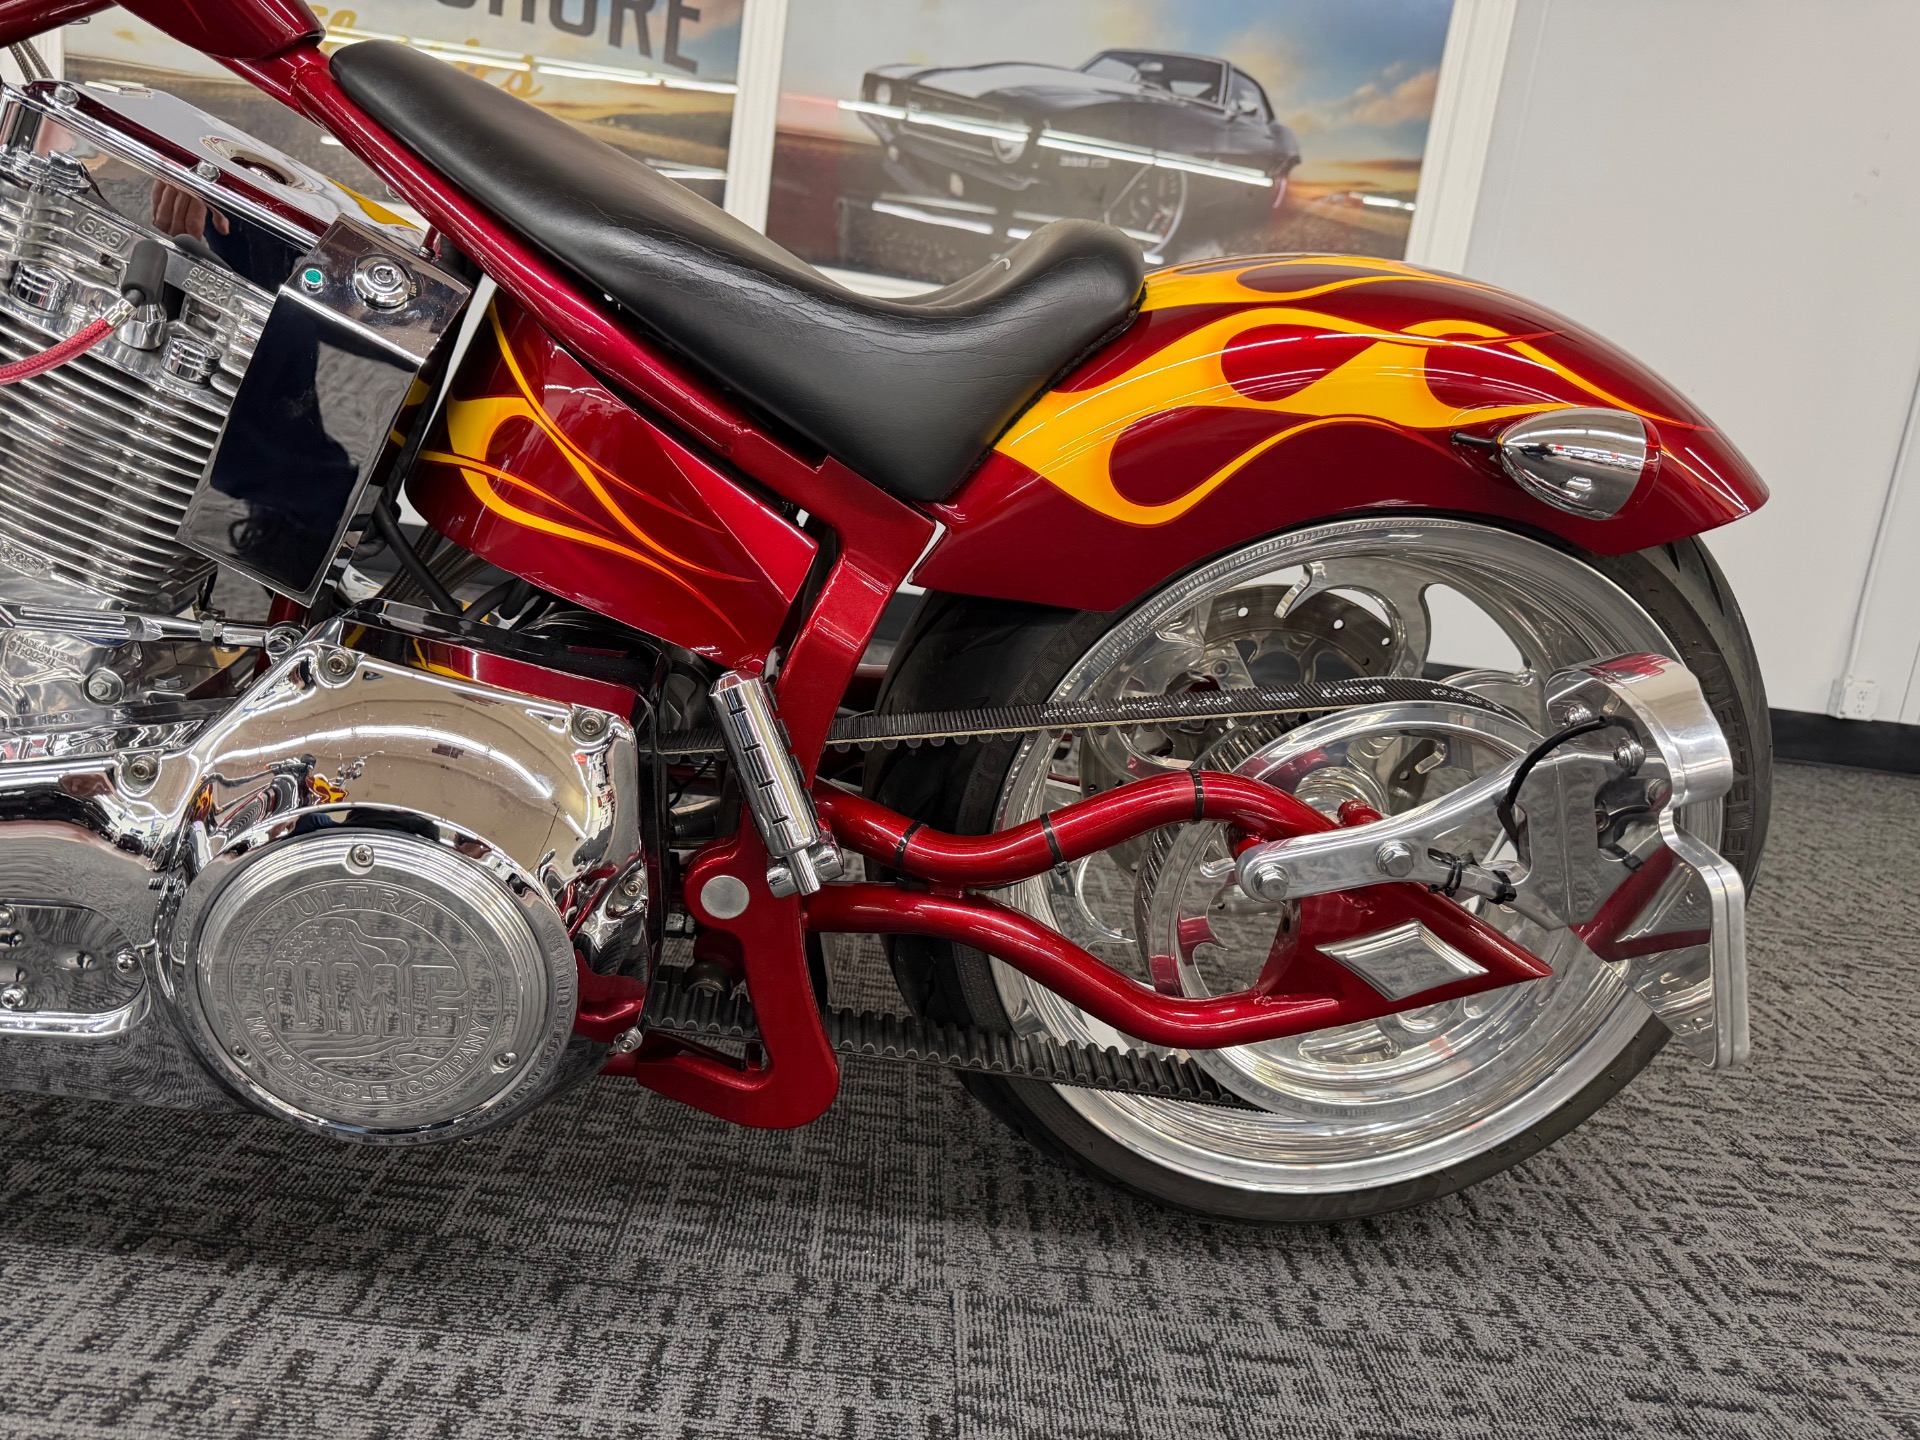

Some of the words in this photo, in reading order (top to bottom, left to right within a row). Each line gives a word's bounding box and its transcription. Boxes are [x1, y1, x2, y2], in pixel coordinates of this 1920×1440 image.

[82, 219, 123, 248] S&S
[182, 278, 228, 303] STOCK
[190, 266, 233, 293] SUPER
[16, 634, 39, 651] MADE
[291, 885, 428, 926] ULTRA
[245, 1015, 389, 1101] MOTORCYCLE
[405, 1020, 491, 1096] COMPANY
